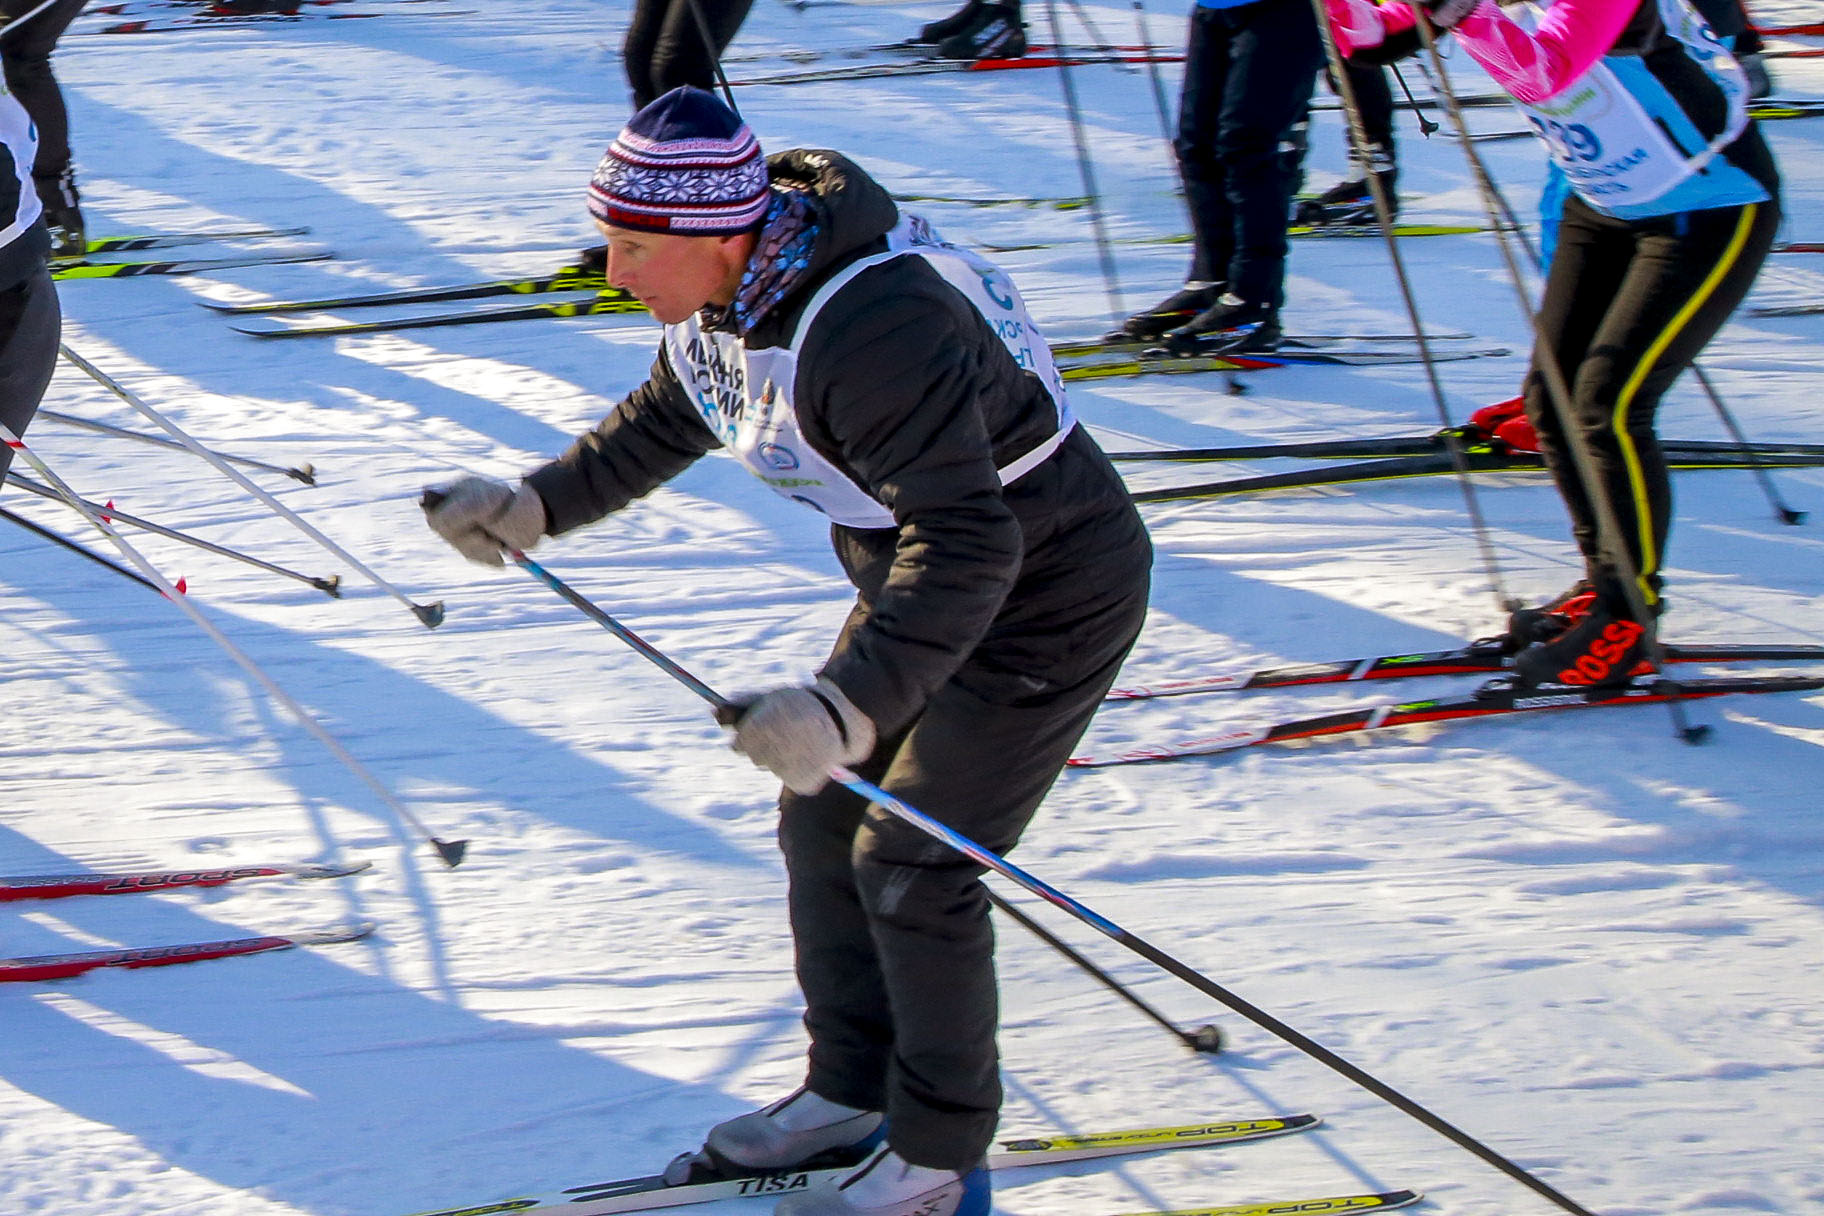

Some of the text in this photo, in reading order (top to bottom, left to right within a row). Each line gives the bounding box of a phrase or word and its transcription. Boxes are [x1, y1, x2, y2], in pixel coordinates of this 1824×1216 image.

[104, 868, 263, 891] SPORT
[1176, 1122, 1268, 1138] TOP
[736, 1174, 809, 1195] TISA
[1267, 1201, 1366, 1215] TOP
